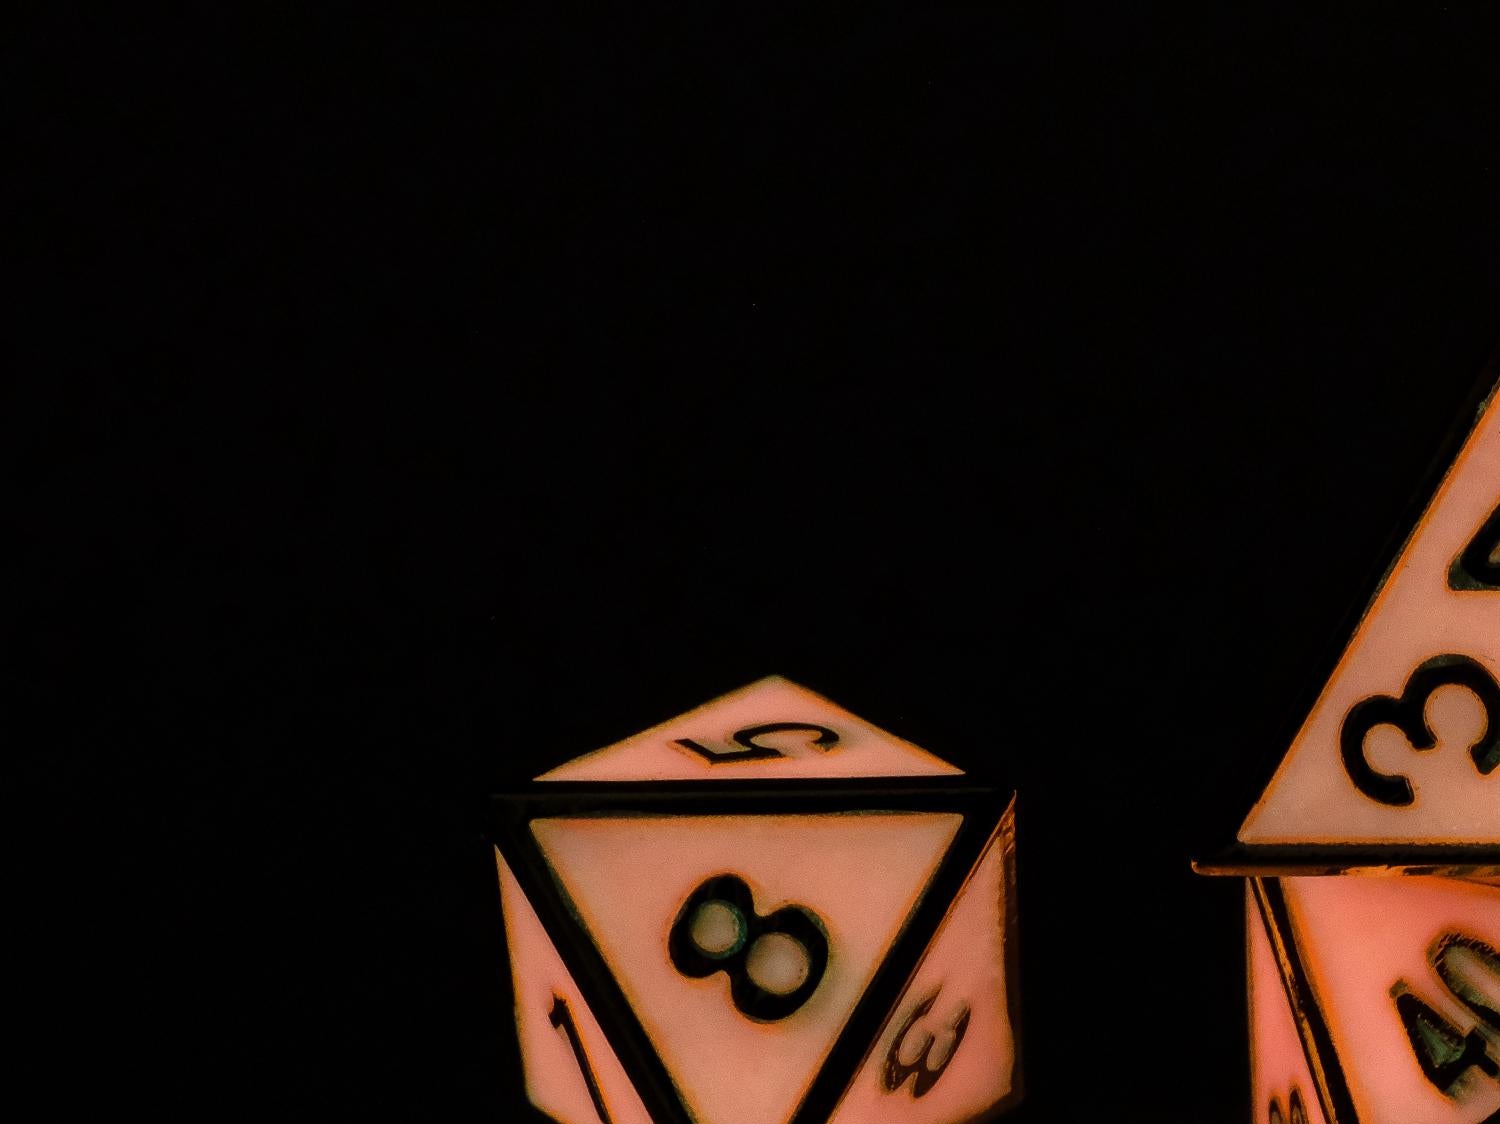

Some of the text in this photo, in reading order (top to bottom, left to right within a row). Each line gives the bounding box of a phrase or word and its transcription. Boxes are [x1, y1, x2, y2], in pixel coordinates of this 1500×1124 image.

[668, 722, 840, 767] 5
[669, 873, 829, 1024] 8
[882, 988, 972, 1098] 3
